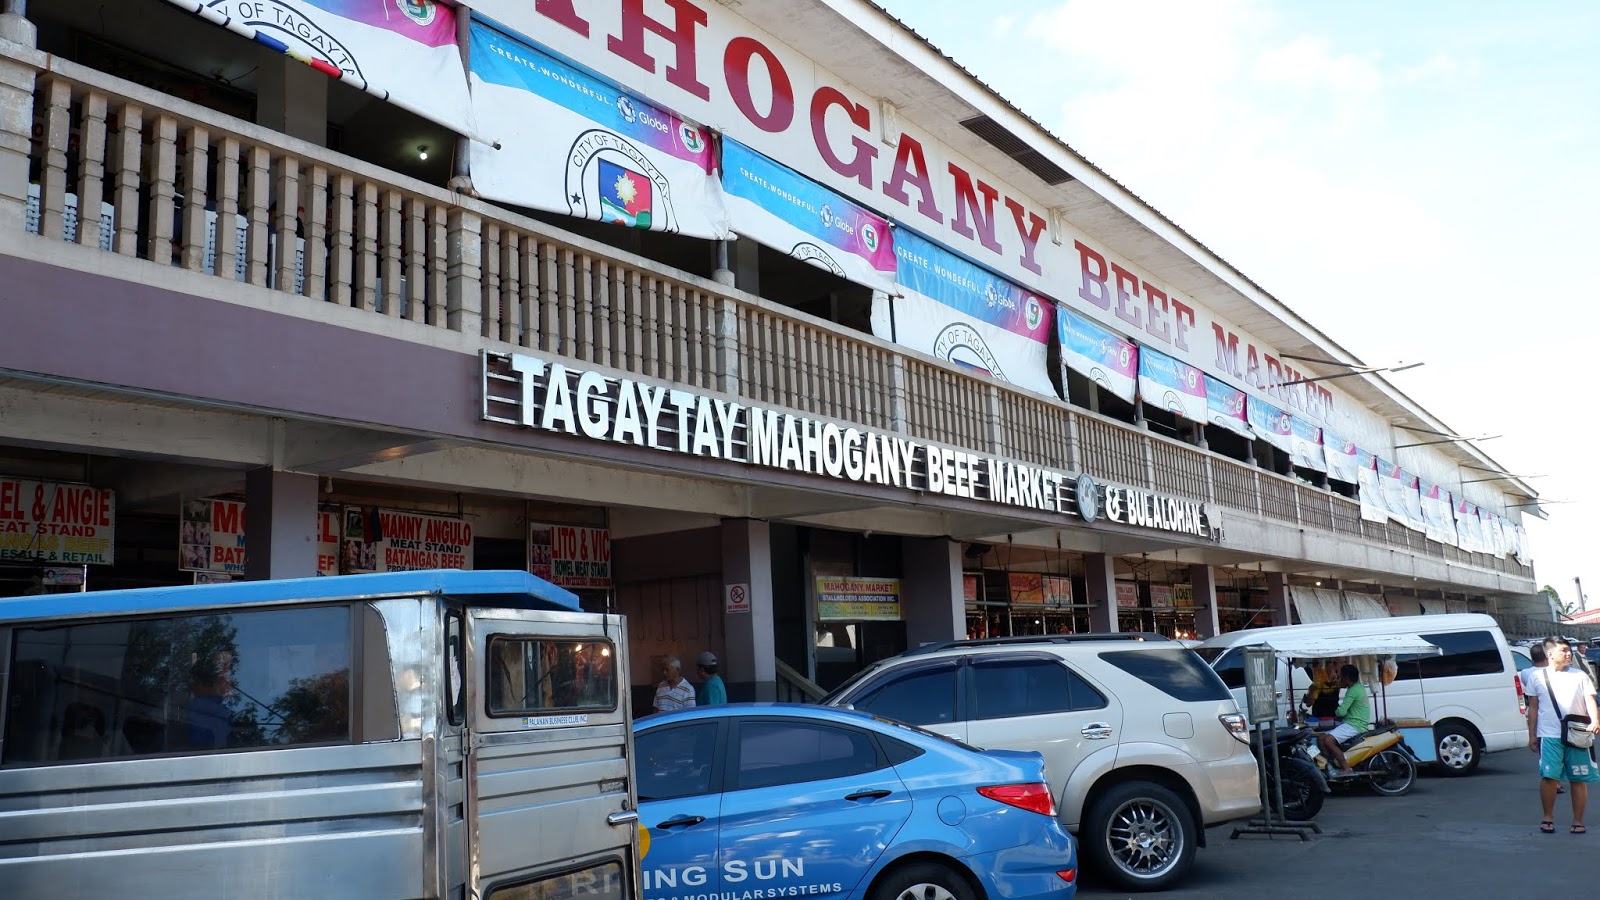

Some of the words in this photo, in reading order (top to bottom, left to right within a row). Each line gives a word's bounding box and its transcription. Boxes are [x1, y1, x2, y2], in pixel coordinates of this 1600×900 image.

[238, 2, 264, 18] OF
[638, 111, 669, 134] Globe
[573, 137, 594, 168] CITY
[593, 134, 608, 146] OF
[611, 136, 669, 202] TAGAYTAY
[834, 216, 854, 235] Globe
[997, 295, 1016, 311] Globe
[947, 329, 960, 344] OF
[1073, 239, 1196, 353] BEEF
[1211, 321, 1335, 427] MARKET
[510, 353, 739, 461] TAGAYTAY
[751, 406, 917, 489] MAHOGANY
[926, 444, 981, 498] BEEF
[988, 459, 1064, 513] MARKET
[1105, 484, 1121, 521] &
[1126, 488, 1202, 536] BULALOHAN
[32, 484, 46, 522] &
[52, 486, 110, 527] ANGIE
[37, 524, 96, 538] STAND
[380, 513, 423, 541] MANNY
[425, 519, 472, 547] ANGULO
[65, 537, 110, 554] BEEF
[390, 539, 422, 550] MEAT
[425, 542, 462, 554] STAND
[551, 526, 576, 561] LITO
[580, 528, 588, 561] &
[591, 529, 609, 562] VIC
[49, 552, 58, 561] &
[63, 552, 106, 564] RETAIL
[213, 546, 248, 564] BAT
[385, 548, 439, 569] BATANGAS
[441, 553, 465, 569] BEEF
[575, 560, 589, 577] MEAT
[591, 562, 608, 577] STAND
[823, 582, 864, 592] MAHOGANY
[866, 583, 893, 593] MARKET
[1253, 657, 1266, 685] NO
[1571, 765, 1589, 776] 25
[723, 858, 806, 884] SUN
[767, 882, 842, 899] SYSTEMS
